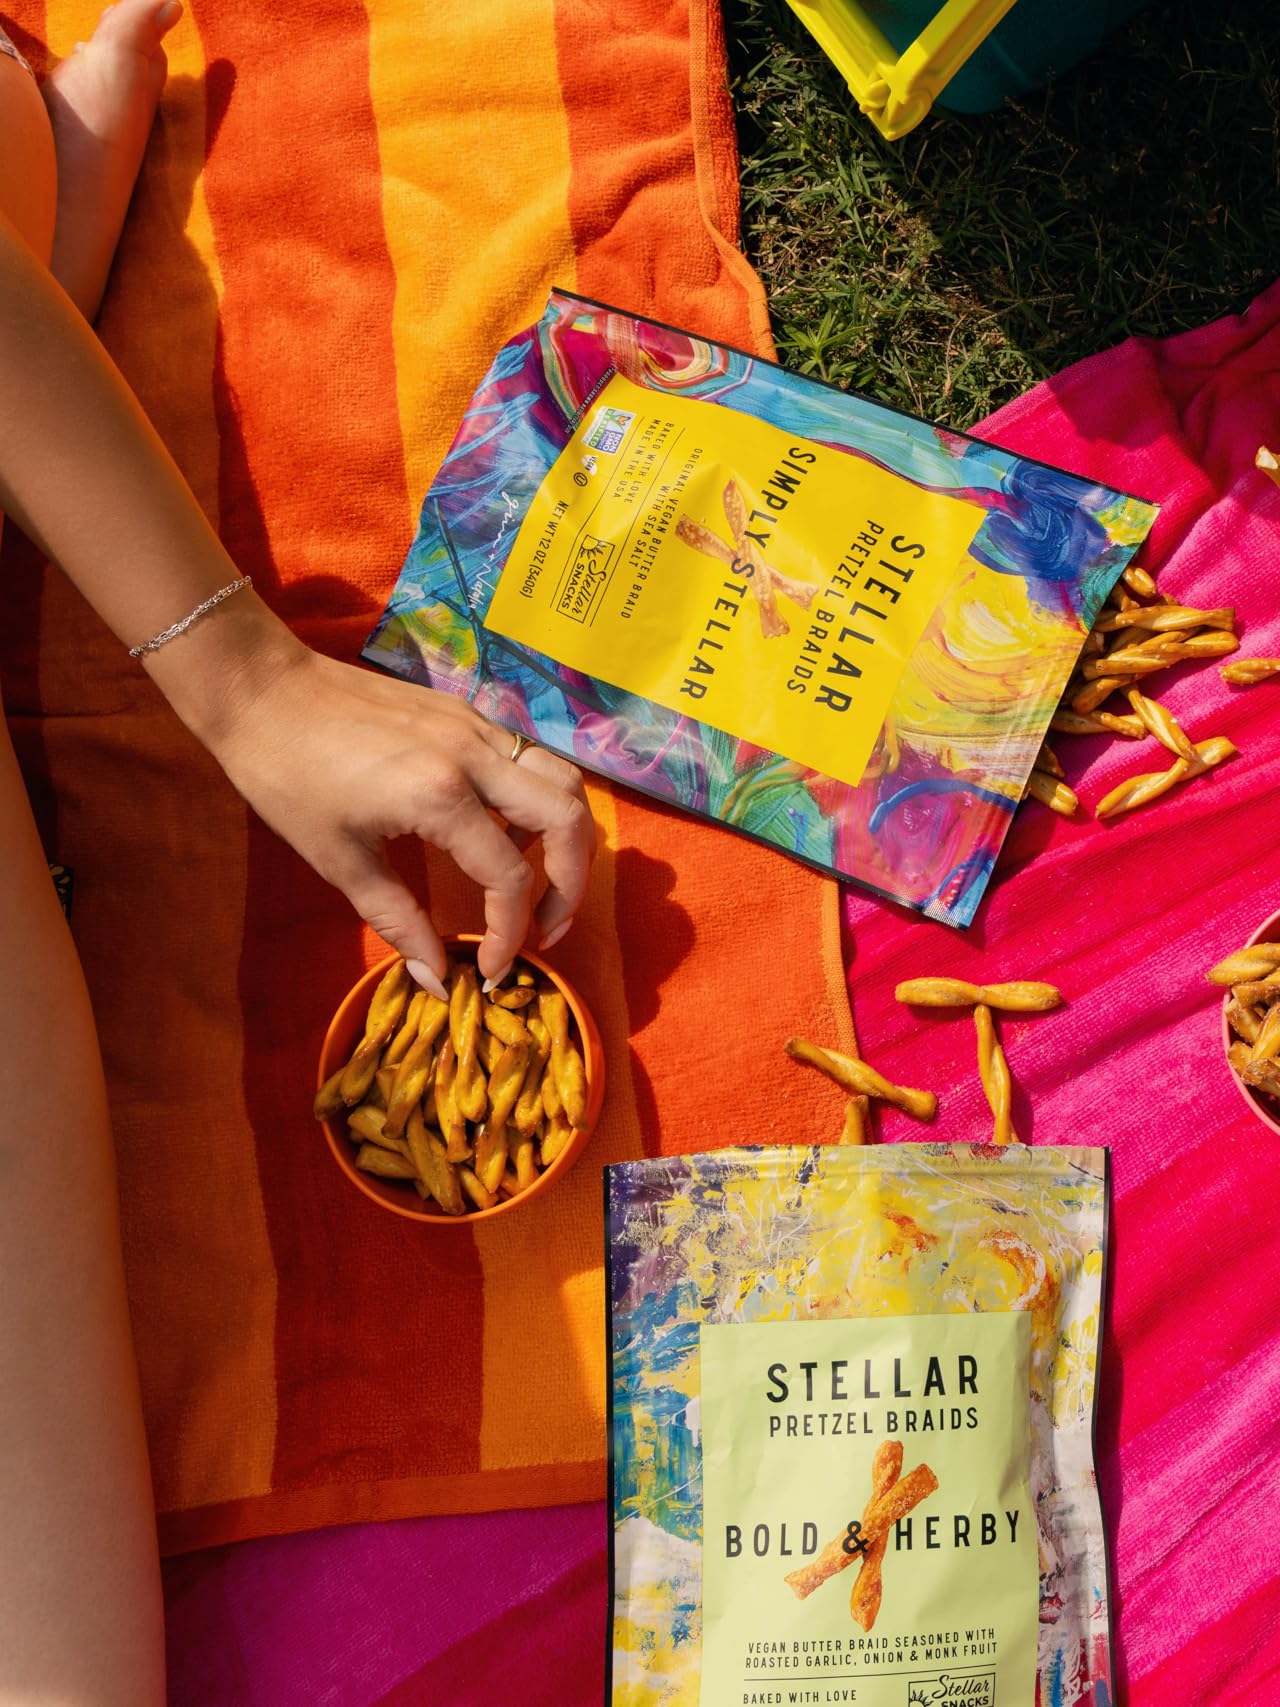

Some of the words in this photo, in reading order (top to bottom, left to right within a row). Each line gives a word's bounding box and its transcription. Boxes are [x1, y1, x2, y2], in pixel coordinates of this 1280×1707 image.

[602, 432, 616, 451] GMO
[609, 432, 622, 452] NON
[641, 419, 661, 440] MADE
[652, 422, 674, 449] BAKED
[634, 445, 646, 455] IN
[624, 460, 639, 475] THE
[639, 454, 656, 477] WITH
[673, 448, 703, 492] ORIGINAL
[613, 480, 627, 498] USA
[624, 480, 642, 504] LOVE
[653, 485, 670, 510] WITH
[743, 447, 817, 549] SIMPLY
[552, 500, 569, 521] NET
[656, 498, 679, 534] VEGAN
[545, 521, 558, 537] WT
[641, 516, 656, 535] SEA
[539, 538, 551, 554] 12
[628, 541, 647, 568] SALT
[637, 538, 662, 580] BUTTER
[533, 552, 547, 567] OZ
[824, 520, 885, 599] PRETZEL
[520, 563, 543, 598] (340G)
[561, 564, 584, 609] SNACKS
[572, 559, 607, 614] Stellar
[621, 585, 642, 619] BRAID
[680, 558, 755, 699] STELLAR
[814, 535, 925, 712] STELLAR
[787, 609, 835, 694] BRAIDS
[765, 1354, 981, 1404] STELLAR
[769, 1411, 874, 1438] PRETZEL
[886, 1407, 980, 1433] BRAIDS
[725, 1521, 817, 1559] BOLD
[842, 1521, 869, 1554] &
[894, 1510, 1020, 1551] HERBY
[748, 1641, 787, 1654] VEGAN
[793, 1640, 843, 1653] BUTTER
[849, 1638, 888, 1650] BRAID
[895, 1631, 959, 1648] SEASONED
[965, 1628, 995, 1641] WITH
[745, 1656, 799, 1669] ROASTED
[806, 1654, 857, 1667] GARLIC,
[864, 1651, 904, 1664] ONION
[909, 1650, 919, 1662] &
[925, 1646, 959, 1660] MONK
[963, 1642, 998, 1656] FRUIT
[743, 1692, 782, 1705] BAKED
[788, 1690, 819, 1703] WITH
[826, 1689, 857, 1701] LOVE
[931, 1674, 990, 1699] Stellar
[941, 1696, 989, 1707] SNACKS
